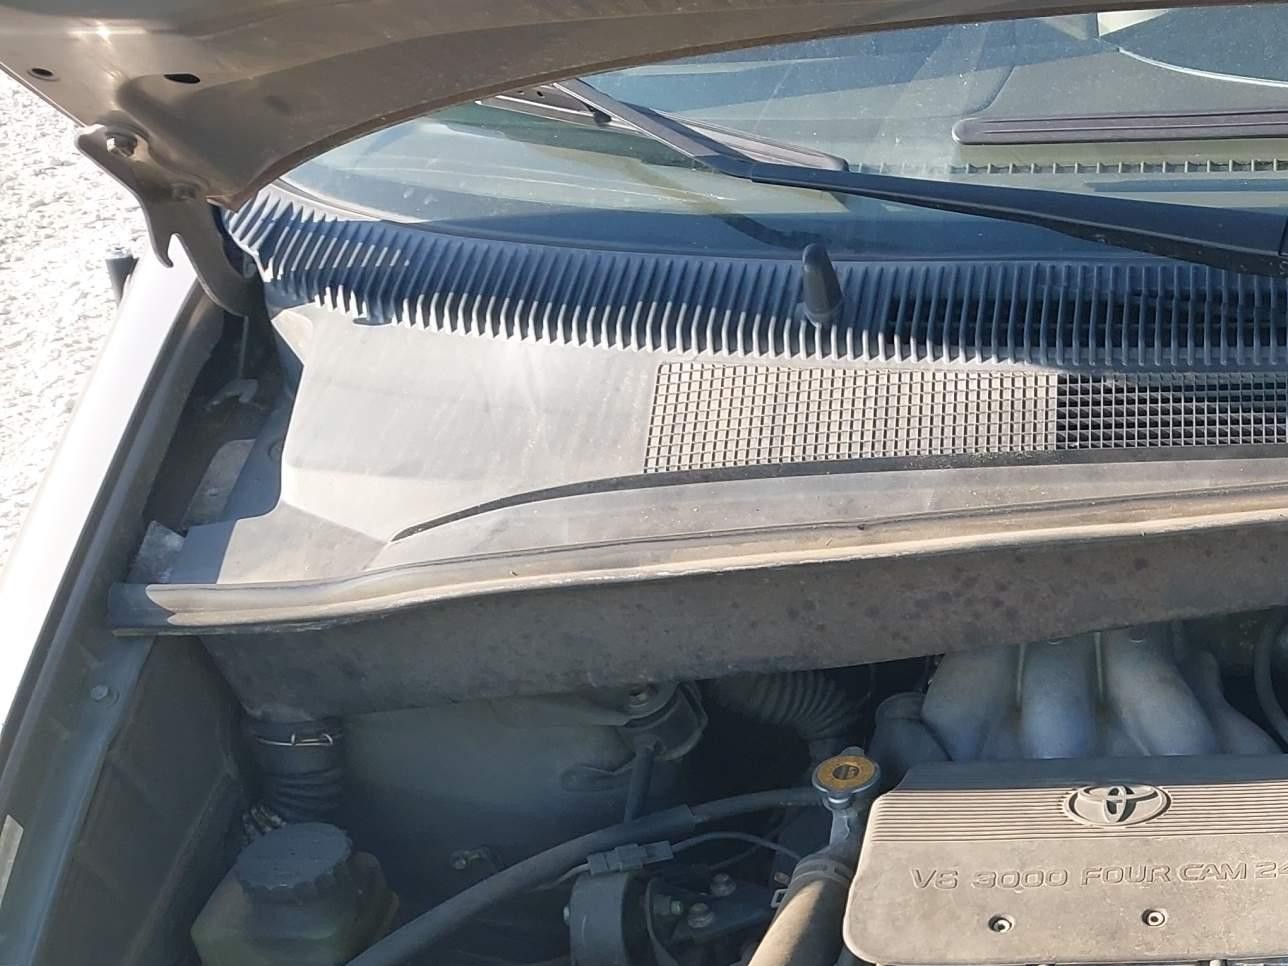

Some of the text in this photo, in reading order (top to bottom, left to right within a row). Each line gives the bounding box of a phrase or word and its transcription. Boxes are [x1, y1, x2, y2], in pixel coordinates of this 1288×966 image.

[971, 868, 1068, 889] 3000
[1081, 864, 1171, 885] FOUR
[1179, 862, 1248, 882] CAM
